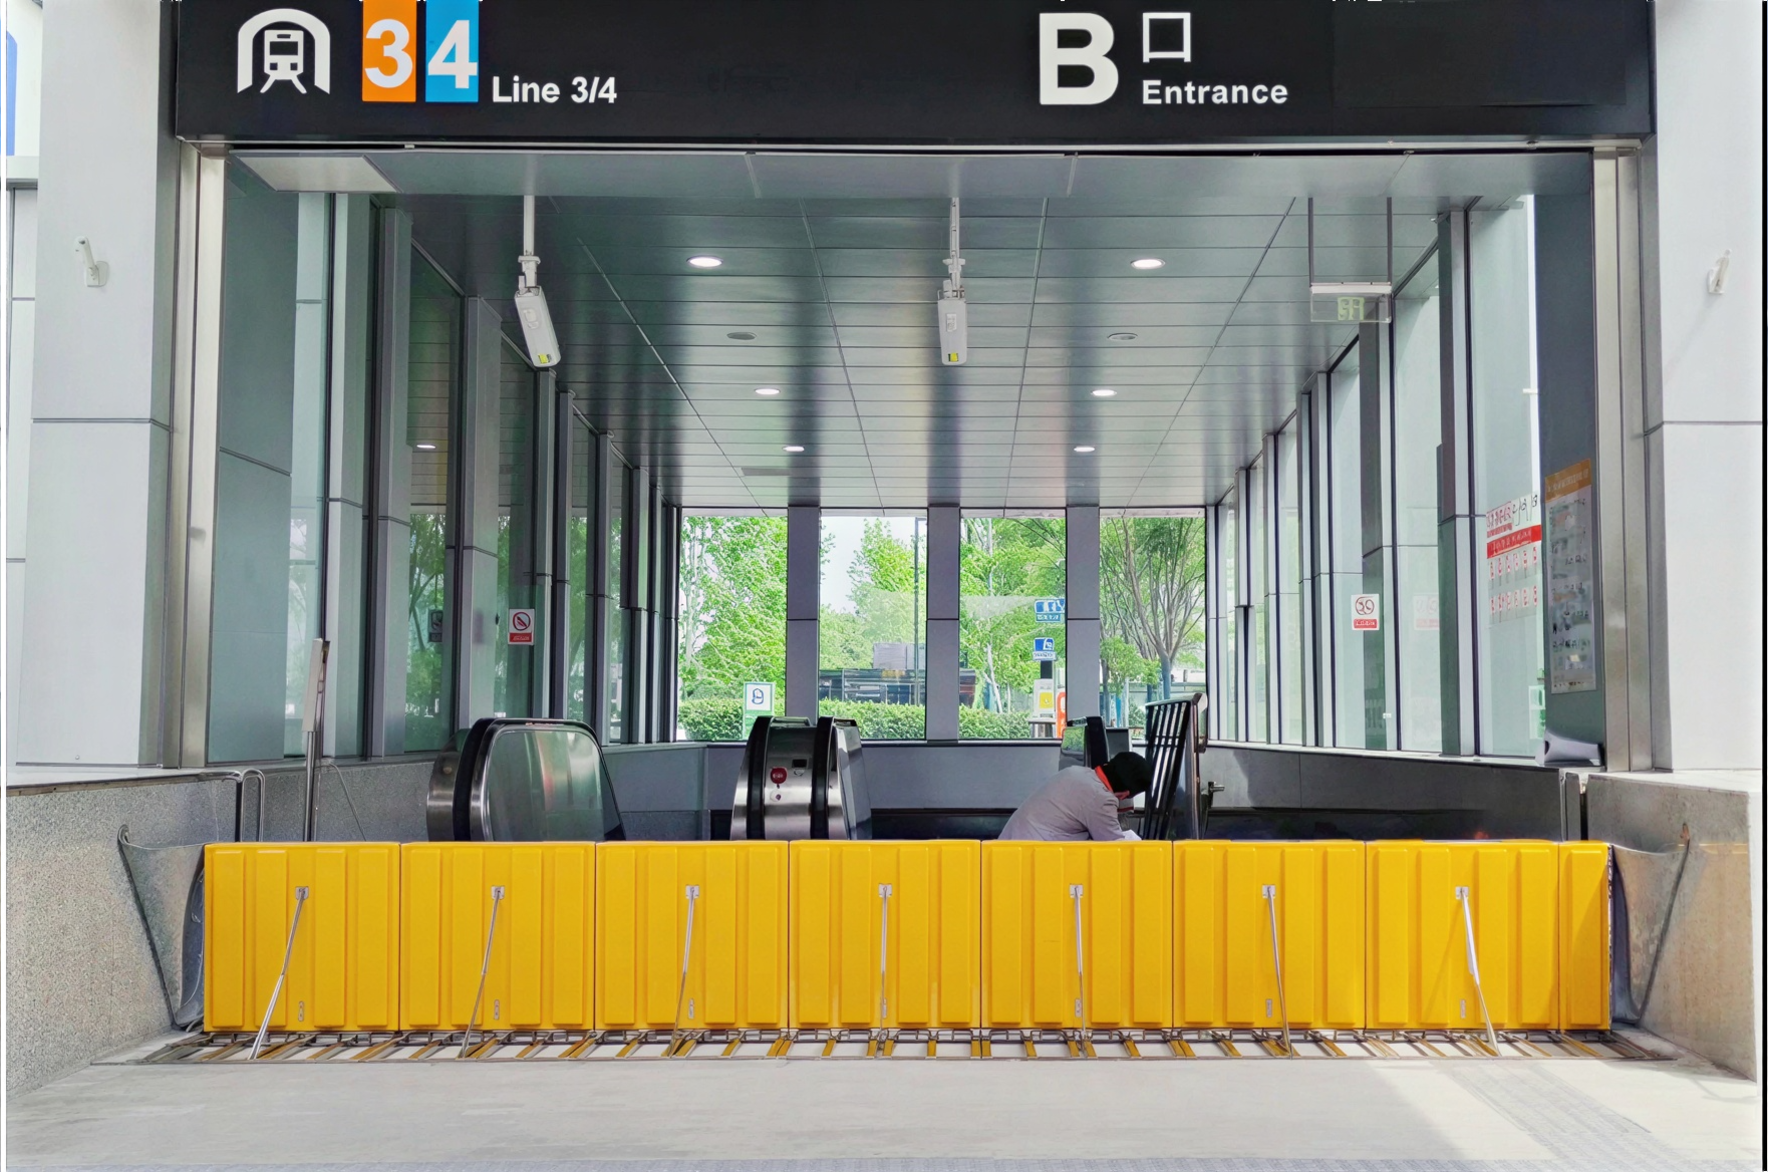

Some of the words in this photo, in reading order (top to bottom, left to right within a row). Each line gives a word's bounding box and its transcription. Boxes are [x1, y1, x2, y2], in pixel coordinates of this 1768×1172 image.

[364, 18, 413, 89] 3
[428, 19, 478, 89] 4
[1038, 12, 1119, 105] B
[492, 75, 561, 104] Line
[570, 76, 618, 104] 3/4
[1142, 79, 1288, 105] Entrance
